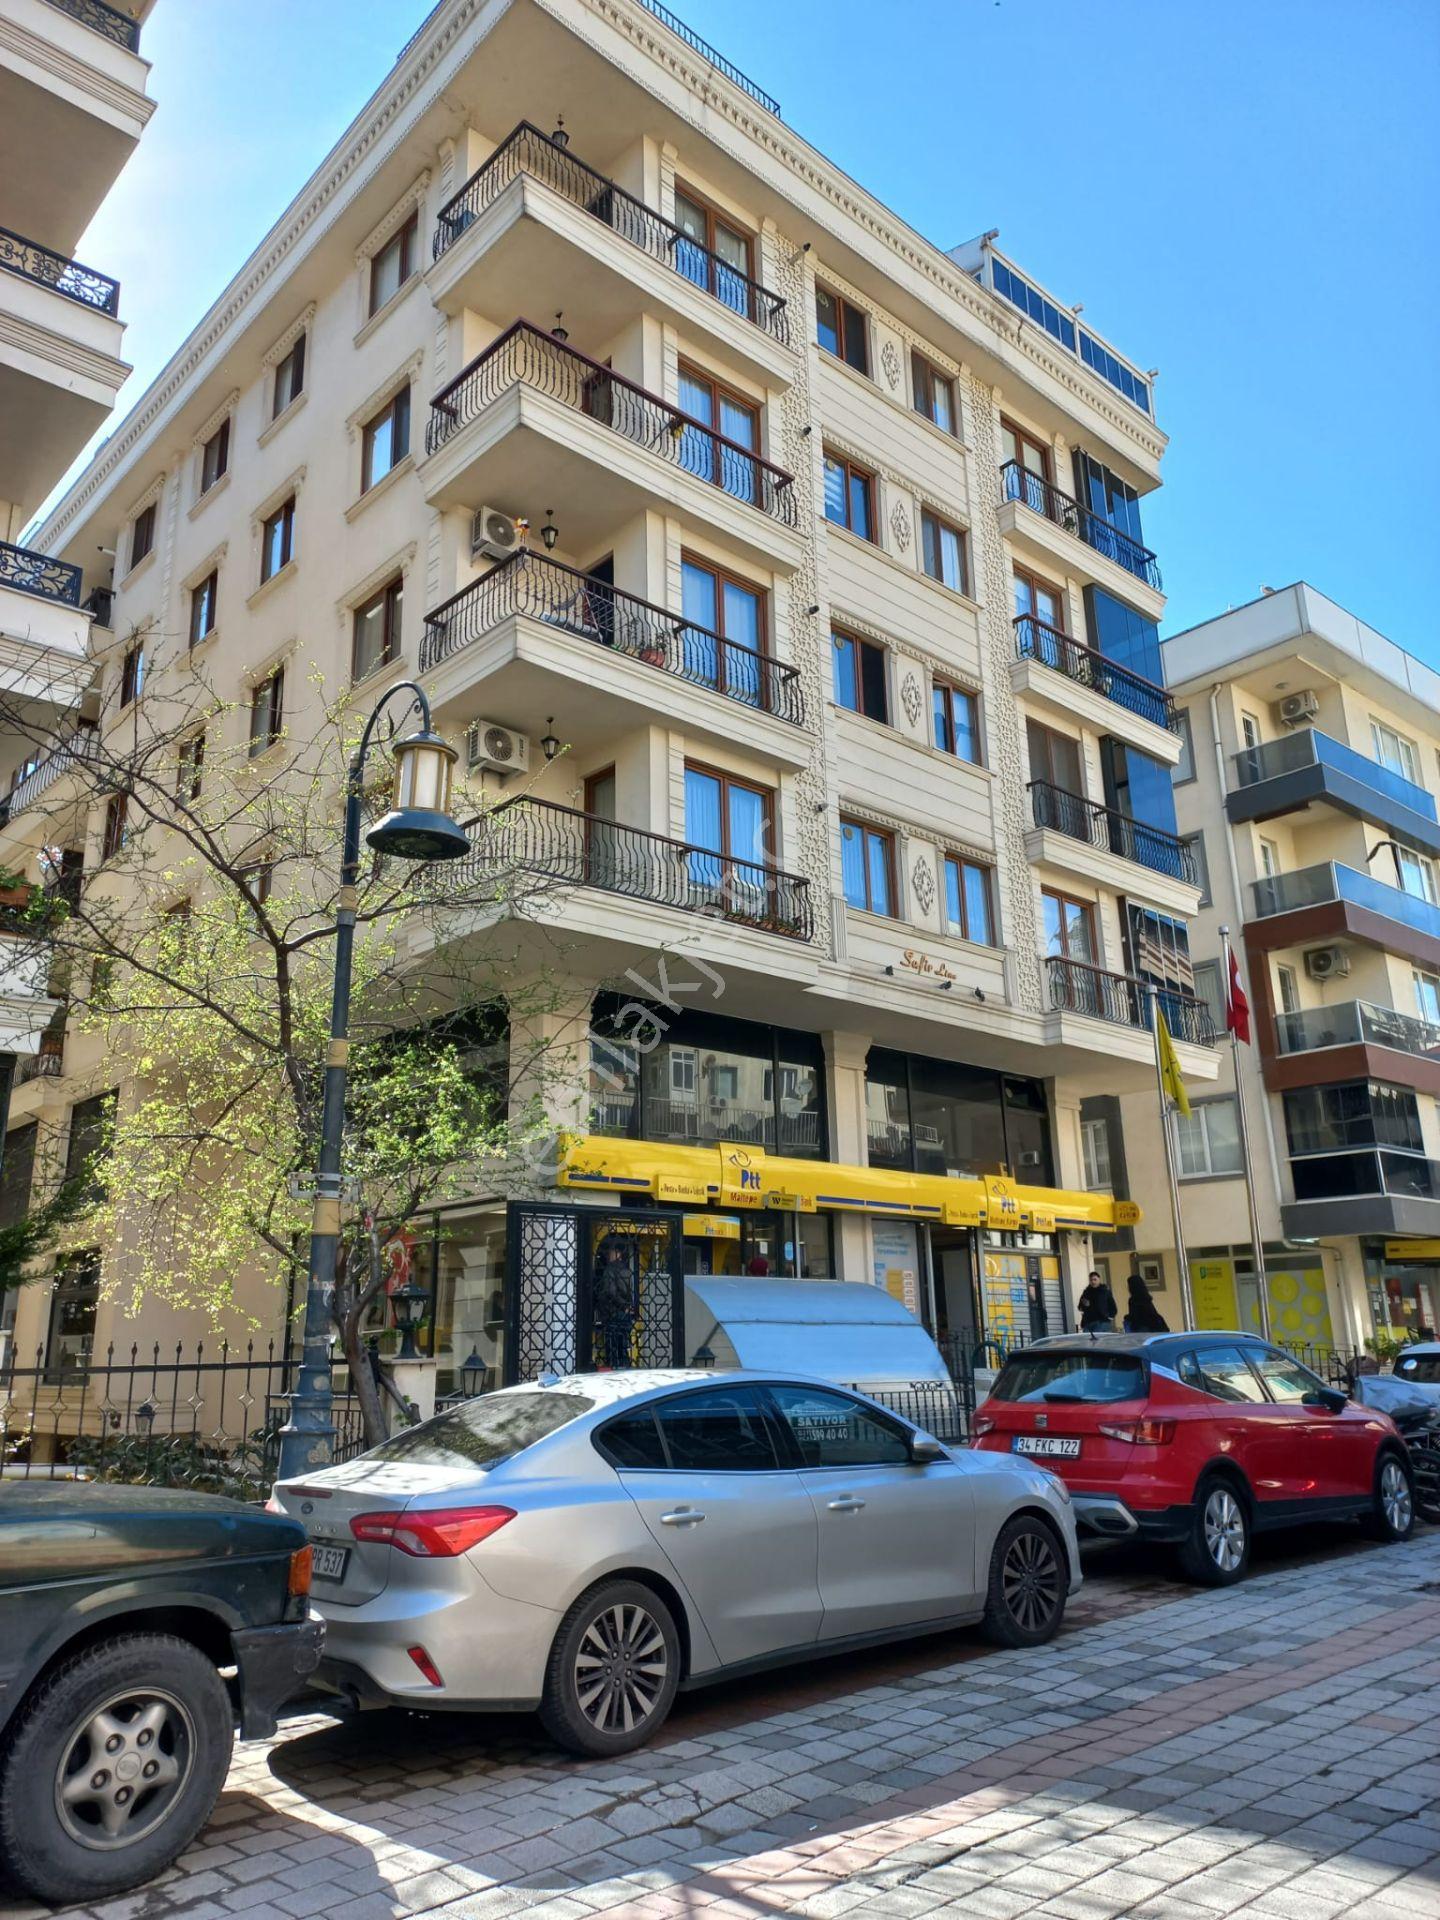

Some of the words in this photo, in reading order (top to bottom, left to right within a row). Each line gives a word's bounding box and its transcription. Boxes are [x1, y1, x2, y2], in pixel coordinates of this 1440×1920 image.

[741, 1169, 760, 1190] Ptt
[730, 1191, 758, 1204] Maltepe
[1001, 1196, 1015, 1214] Ptt
[798, 1415, 847, 1426] SATIYOR
[1019, 1438, 1031, 1450] 34
[1034, 1439, 1054, 1453] FKC
[1060, 1440, 1078, 1454] 122
[324, 1549, 343, 1574] 537
